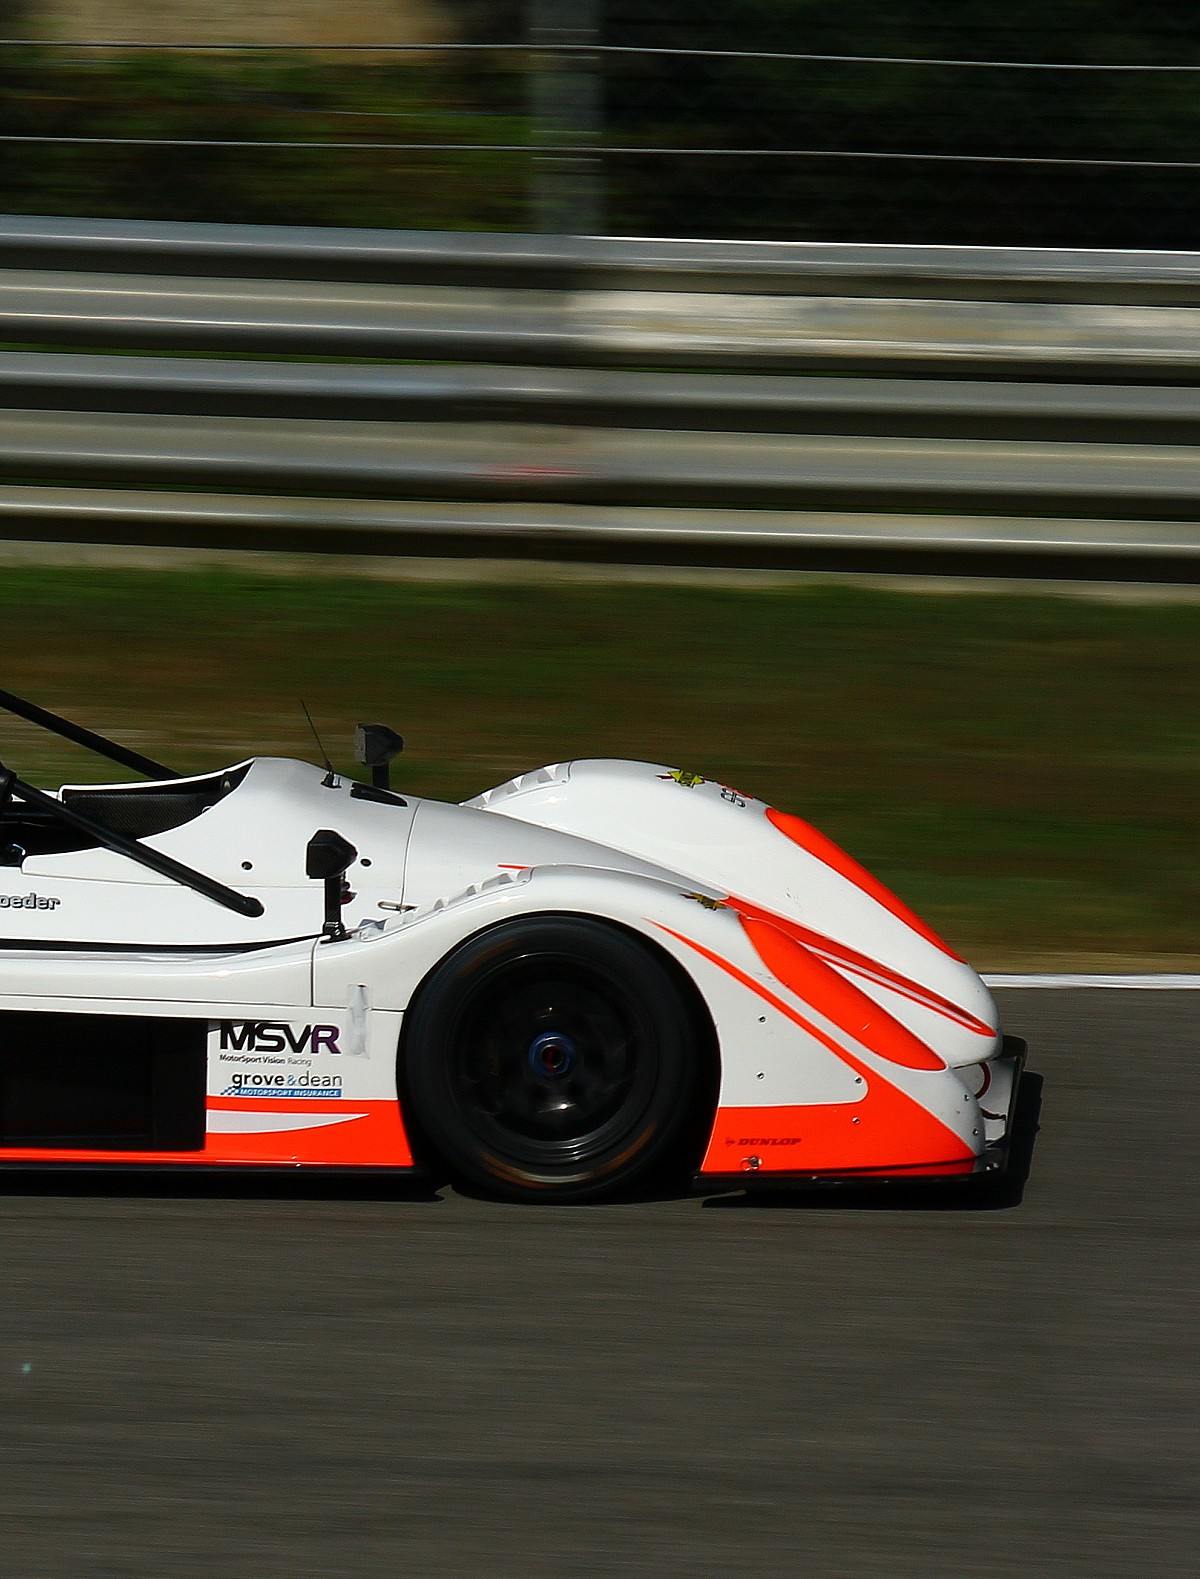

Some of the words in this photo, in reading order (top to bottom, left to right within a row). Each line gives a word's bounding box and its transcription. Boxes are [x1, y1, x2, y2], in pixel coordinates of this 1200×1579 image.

[220, 1021, 342, 1054] MSVR
[220, 1054, 261, 1064] MotorSport
[263, 1056, 286, 1064] Vision
[288, 1058, 312, 1067] Racing
[232, 1073, 285, 1088] grove
[298, 1071, 342, 1087] dean
[240, 1088, 292, 1096] MOTORSPORT
[294, 1089, 339, 1097] INSURANCE
[738, 1138, 801, 1146] DUNLOP
